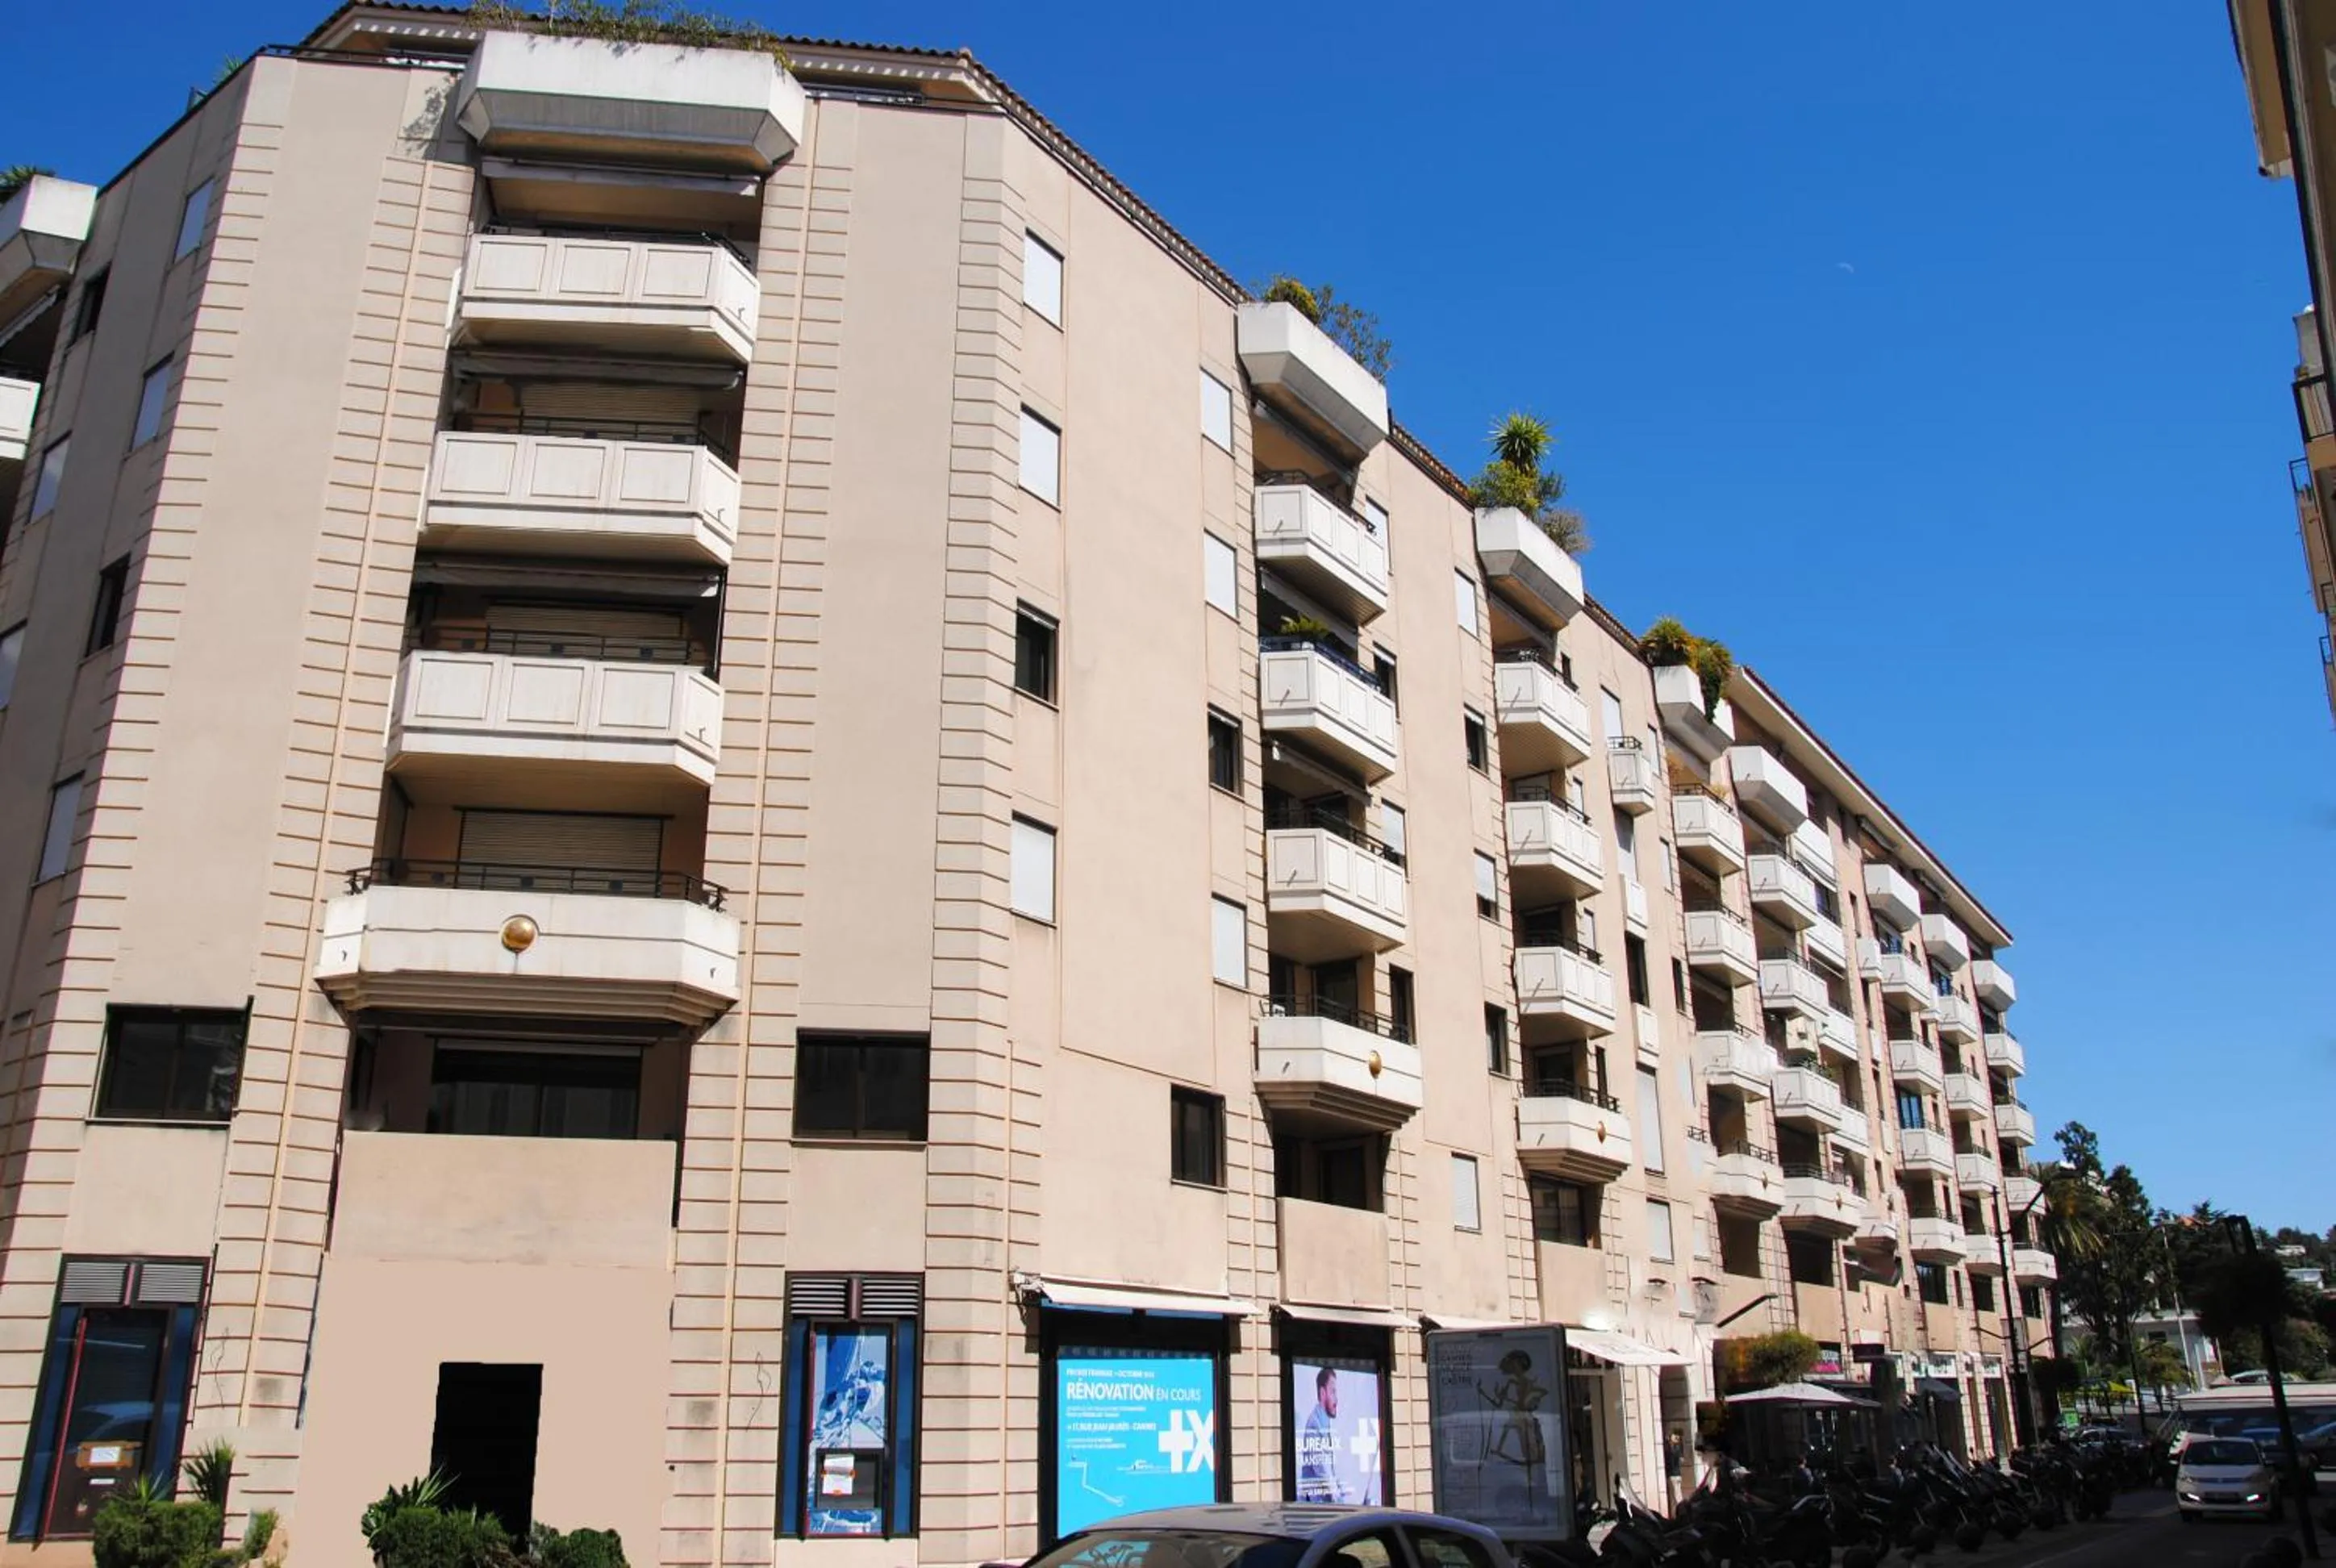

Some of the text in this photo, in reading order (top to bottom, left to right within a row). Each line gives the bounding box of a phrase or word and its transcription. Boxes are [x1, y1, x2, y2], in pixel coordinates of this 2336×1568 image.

[1066, 1377, 1201, 1402] RÉNOVATION EN COURS
